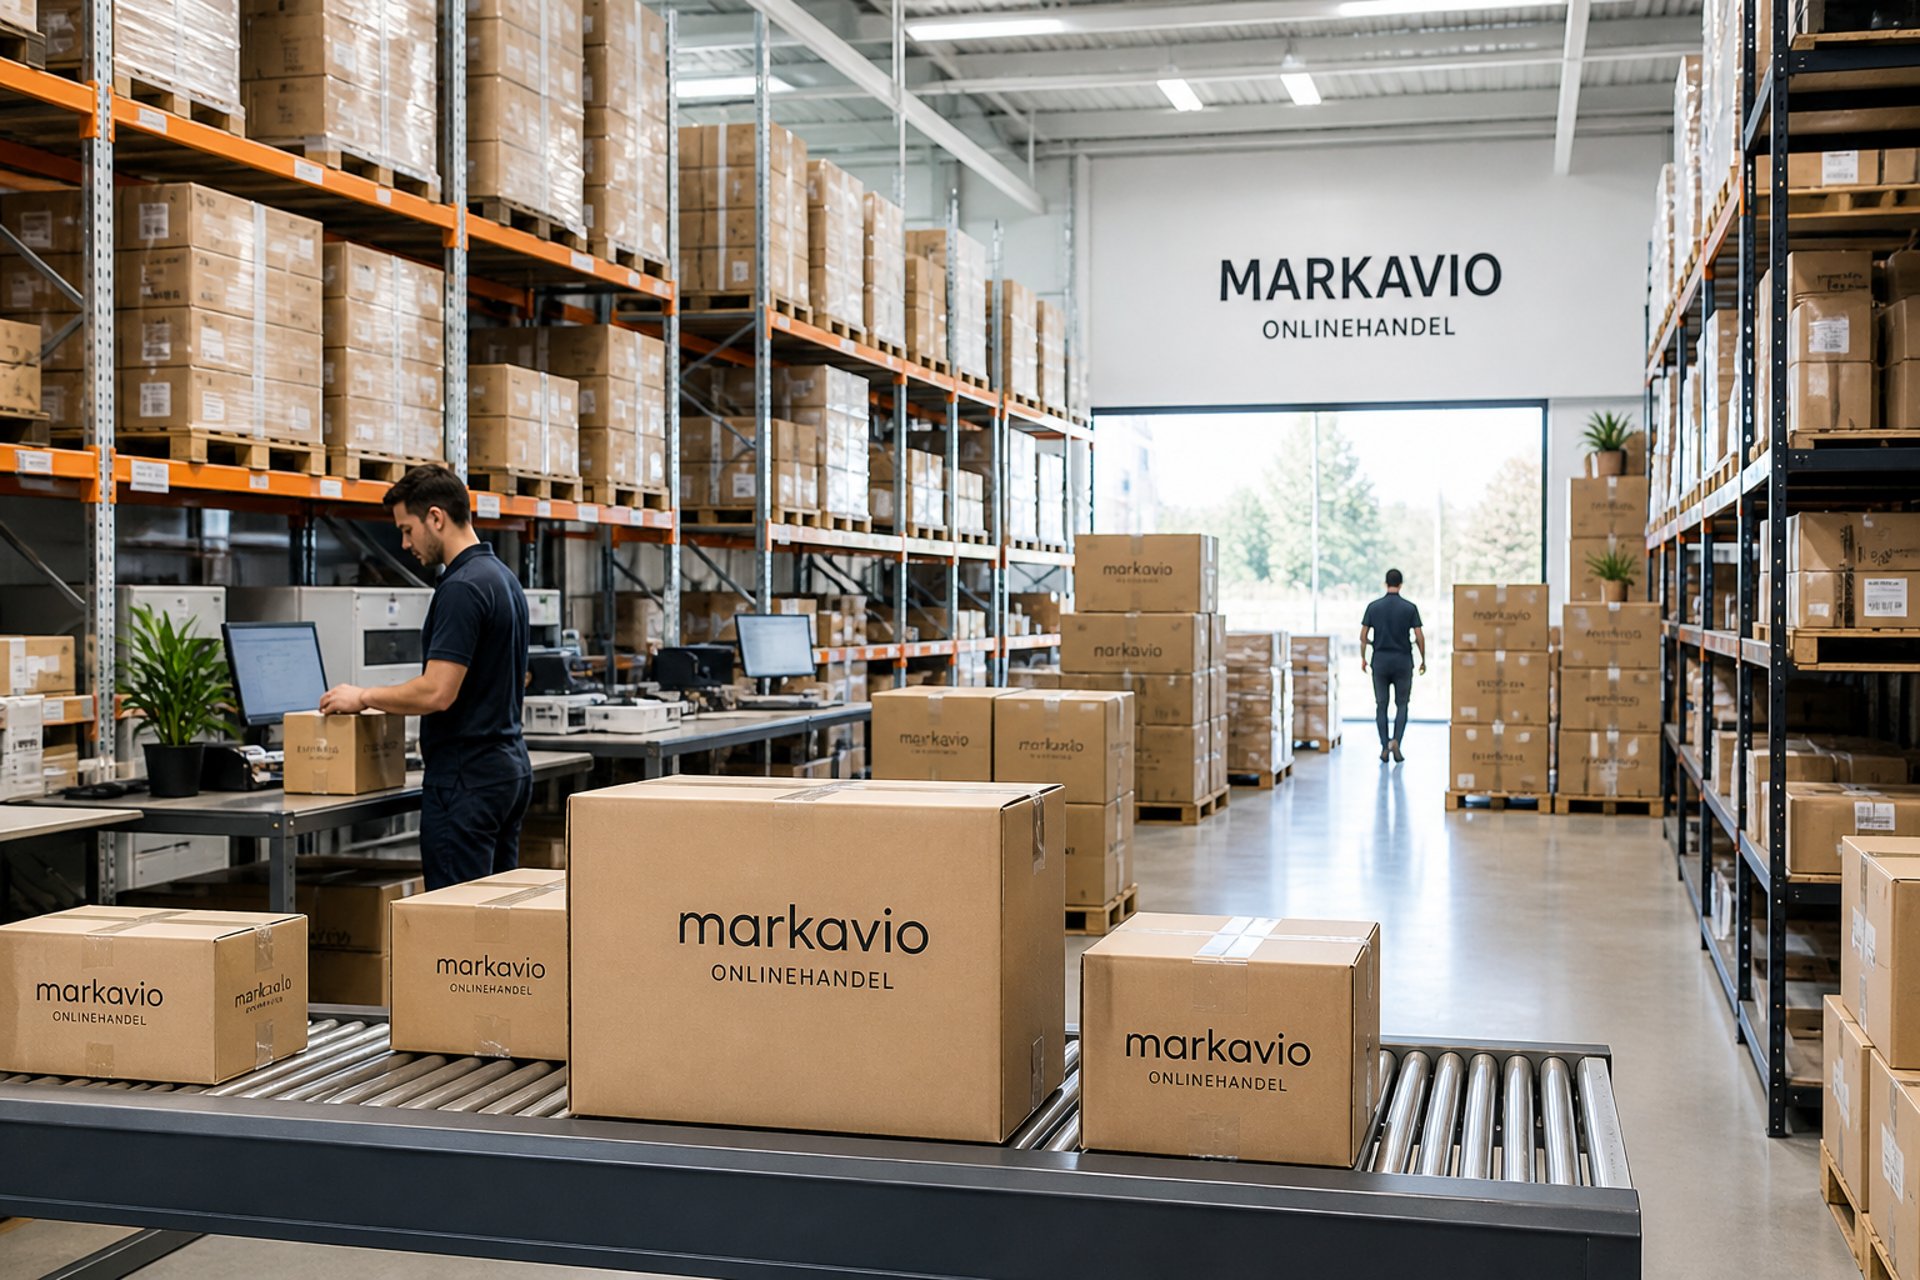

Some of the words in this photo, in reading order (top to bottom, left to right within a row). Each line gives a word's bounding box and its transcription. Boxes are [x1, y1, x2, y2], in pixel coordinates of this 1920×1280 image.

[1220, 252, 1502, 301] MARKAVIO
[1262, 316, 1456, 339] ONLINEHANDEL
[1103, 561, 1173, 576] markavio
[679, 903, 930, 955] markavio
[437, 954, 546, 979] markavio
[711, 964, 894, 989] ONLINEHANDEL
[36, 978, 163, 1007] markavio
[450, 983, 532, 996] ONLINEHANDEL
[52, 1010, 147, 1026] ONLINEHANDEL
[1125, 1028, 1311, 1067] markavio
[1149, 1070, 1288, 1092] ONLINEHANDEL
